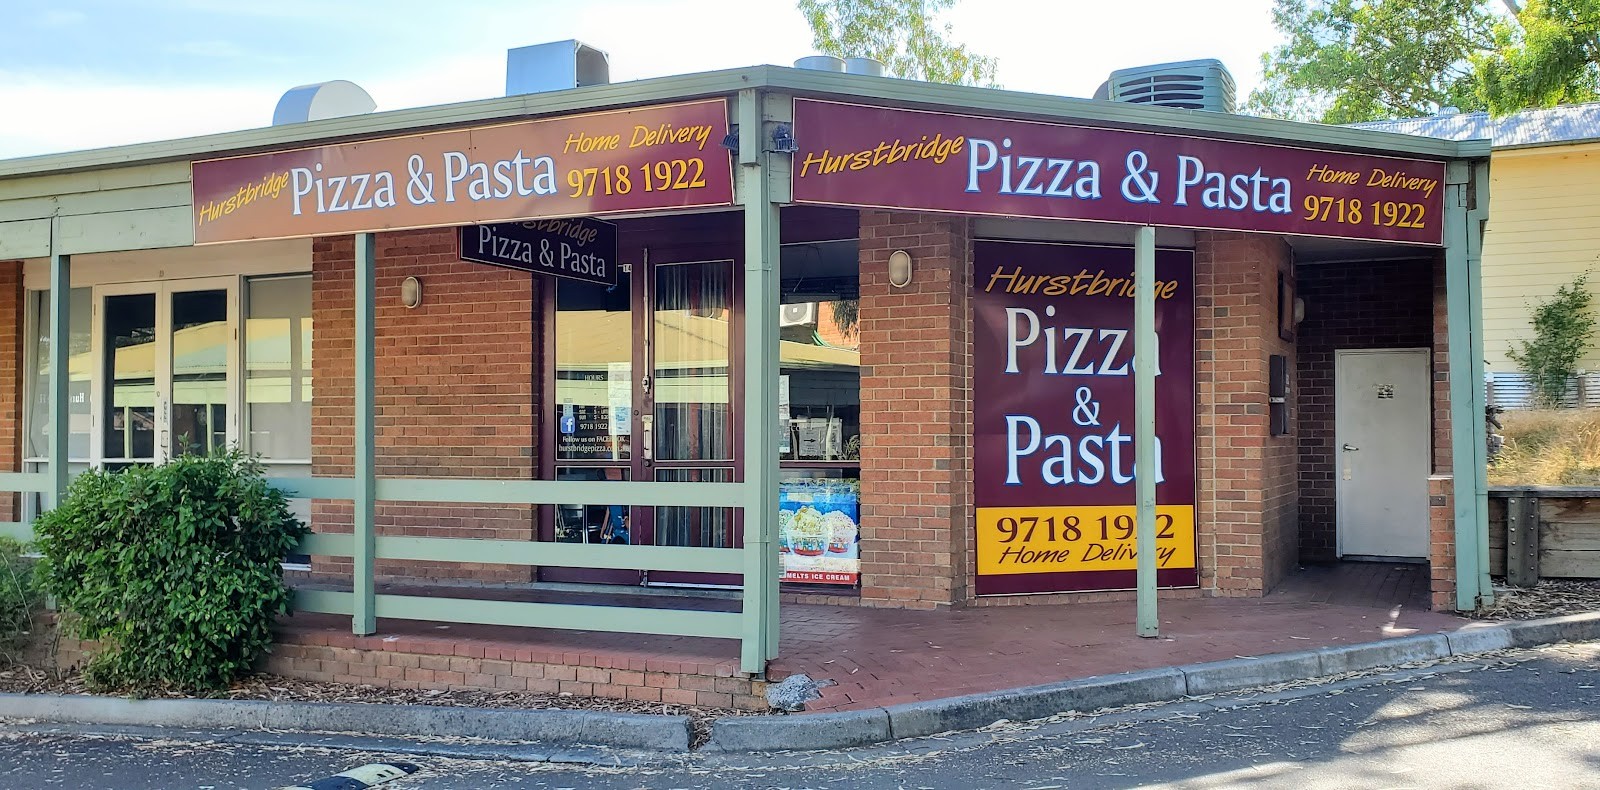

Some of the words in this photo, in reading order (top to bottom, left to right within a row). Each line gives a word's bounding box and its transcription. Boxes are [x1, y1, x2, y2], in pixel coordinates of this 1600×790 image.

[564, 131, 622, 154] Home
[629, 122, 712, 151] Delivery
[199, 169, 290, 225] Hurstbridge
[291, 163, 396, 215] Pizza
[405, 152, 436, 205] &
[444, 148, 557, 202] Pasta
[567, 164, 632, 199] 9718
[640, 157, 707, 193] 1922
[801, 133, 965, 178] Hurstbridge
[965, 138, 1102, 200] Pizza
[1121, 149, 1162, 205] &
[1174, 154, 1293, 214] Pasta
[1306, 163, 1361, 186] Home
[1366, 167, 1438, 199] Delivery
[1303, 195, 1363, 225] 9718
[1371, 201, 1426, 229] 1922
[511, 218, 598, 247] stbridge
[478, 224, 533, 264] Pizza
[539, 238, 554, 267] &
[560, 242, 606, 278] Pasta
[985, 265, 1178, 300] Hurstbrie
[1072, 386, 1100, 426] &
[996, 515, 1083, 543] 9718
[1095, 513, 1175, 541] 192
[998, 546, 1070, 566] Home
[1081, 543, 1176, 568] Delivy
